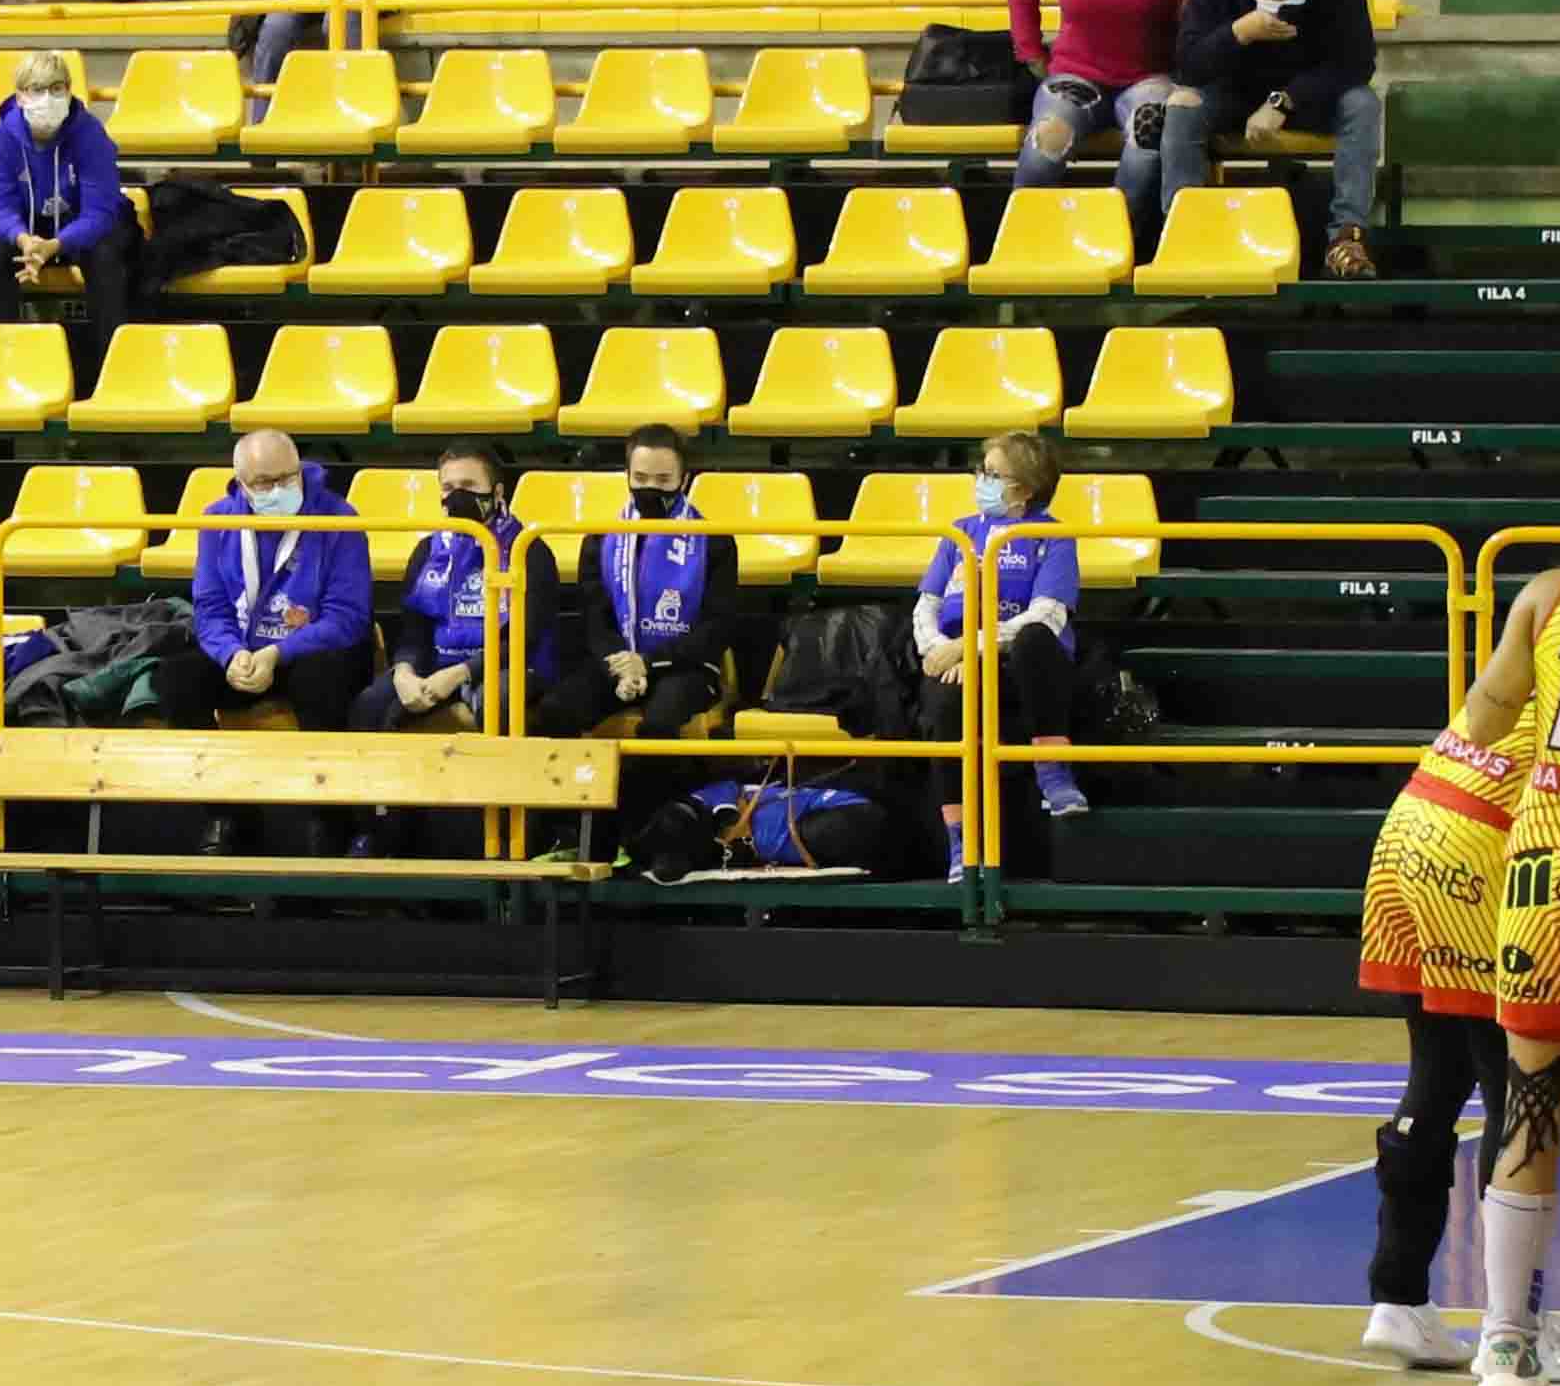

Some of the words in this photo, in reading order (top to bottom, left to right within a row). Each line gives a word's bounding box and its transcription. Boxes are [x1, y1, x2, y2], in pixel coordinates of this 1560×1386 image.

[1515, 286, 1526, 300] 4
[1412, 430, 1447, 444] FILA
[1451, 429, 1461, 444] 3
[1339, 581, 1376, 595] FILA
[1379, 581, 1390, 595] 2
